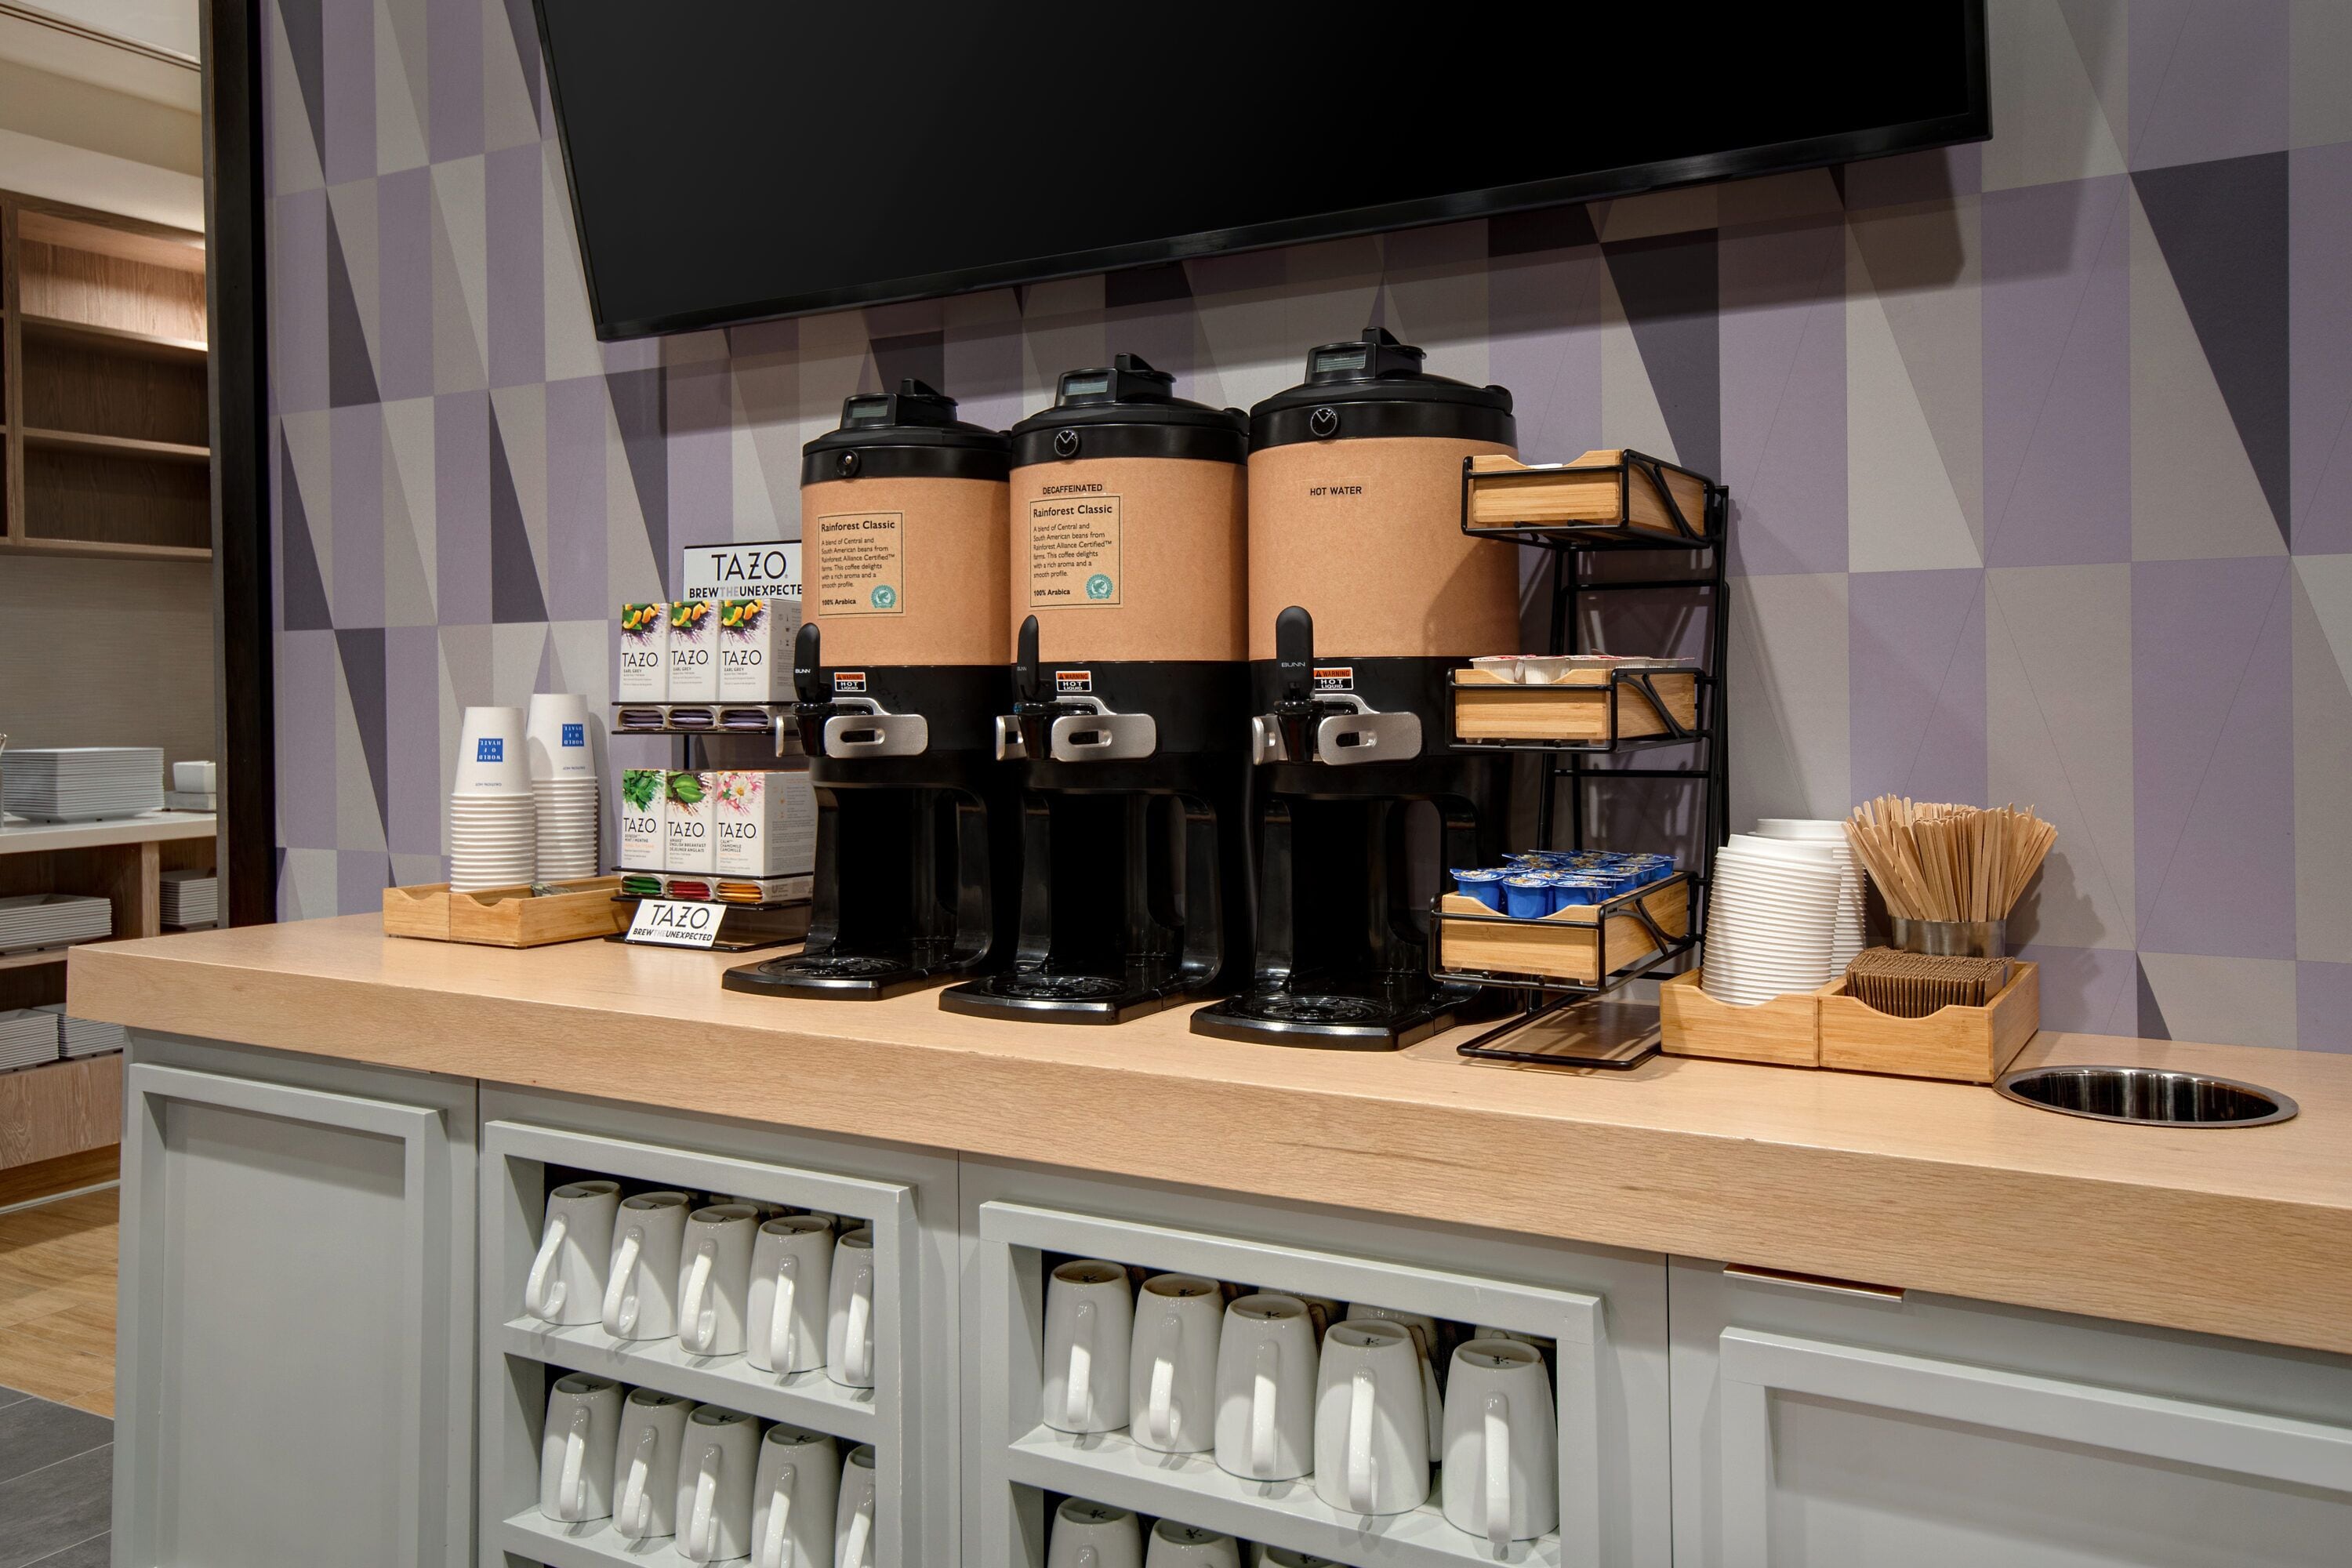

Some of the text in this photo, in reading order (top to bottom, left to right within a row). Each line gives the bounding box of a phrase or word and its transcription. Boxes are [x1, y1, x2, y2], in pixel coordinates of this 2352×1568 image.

[1043, 484, 1102, 495] DECAFFEINATED
[1330, 486, 1362, 495] WATER
[1033, 505, 1112, 517] Rainforest Classic
[821, 521, 895, 532] Rainforest Classic
[711, 550, 786, 581] TAZO
[739, 584, 802, 596] UNEXPECTE
[622, 652, 659, 667] TAZO
[671, 650, 709, 665] TAZO
[722, 650, 762, 666] TAZO
[623, 818, 656, 833] TAZO
[668, 821, 705, 837] TAZO
[718, 822, 757, 839] TAZO
[651, 904, 710, 930] TAZO
